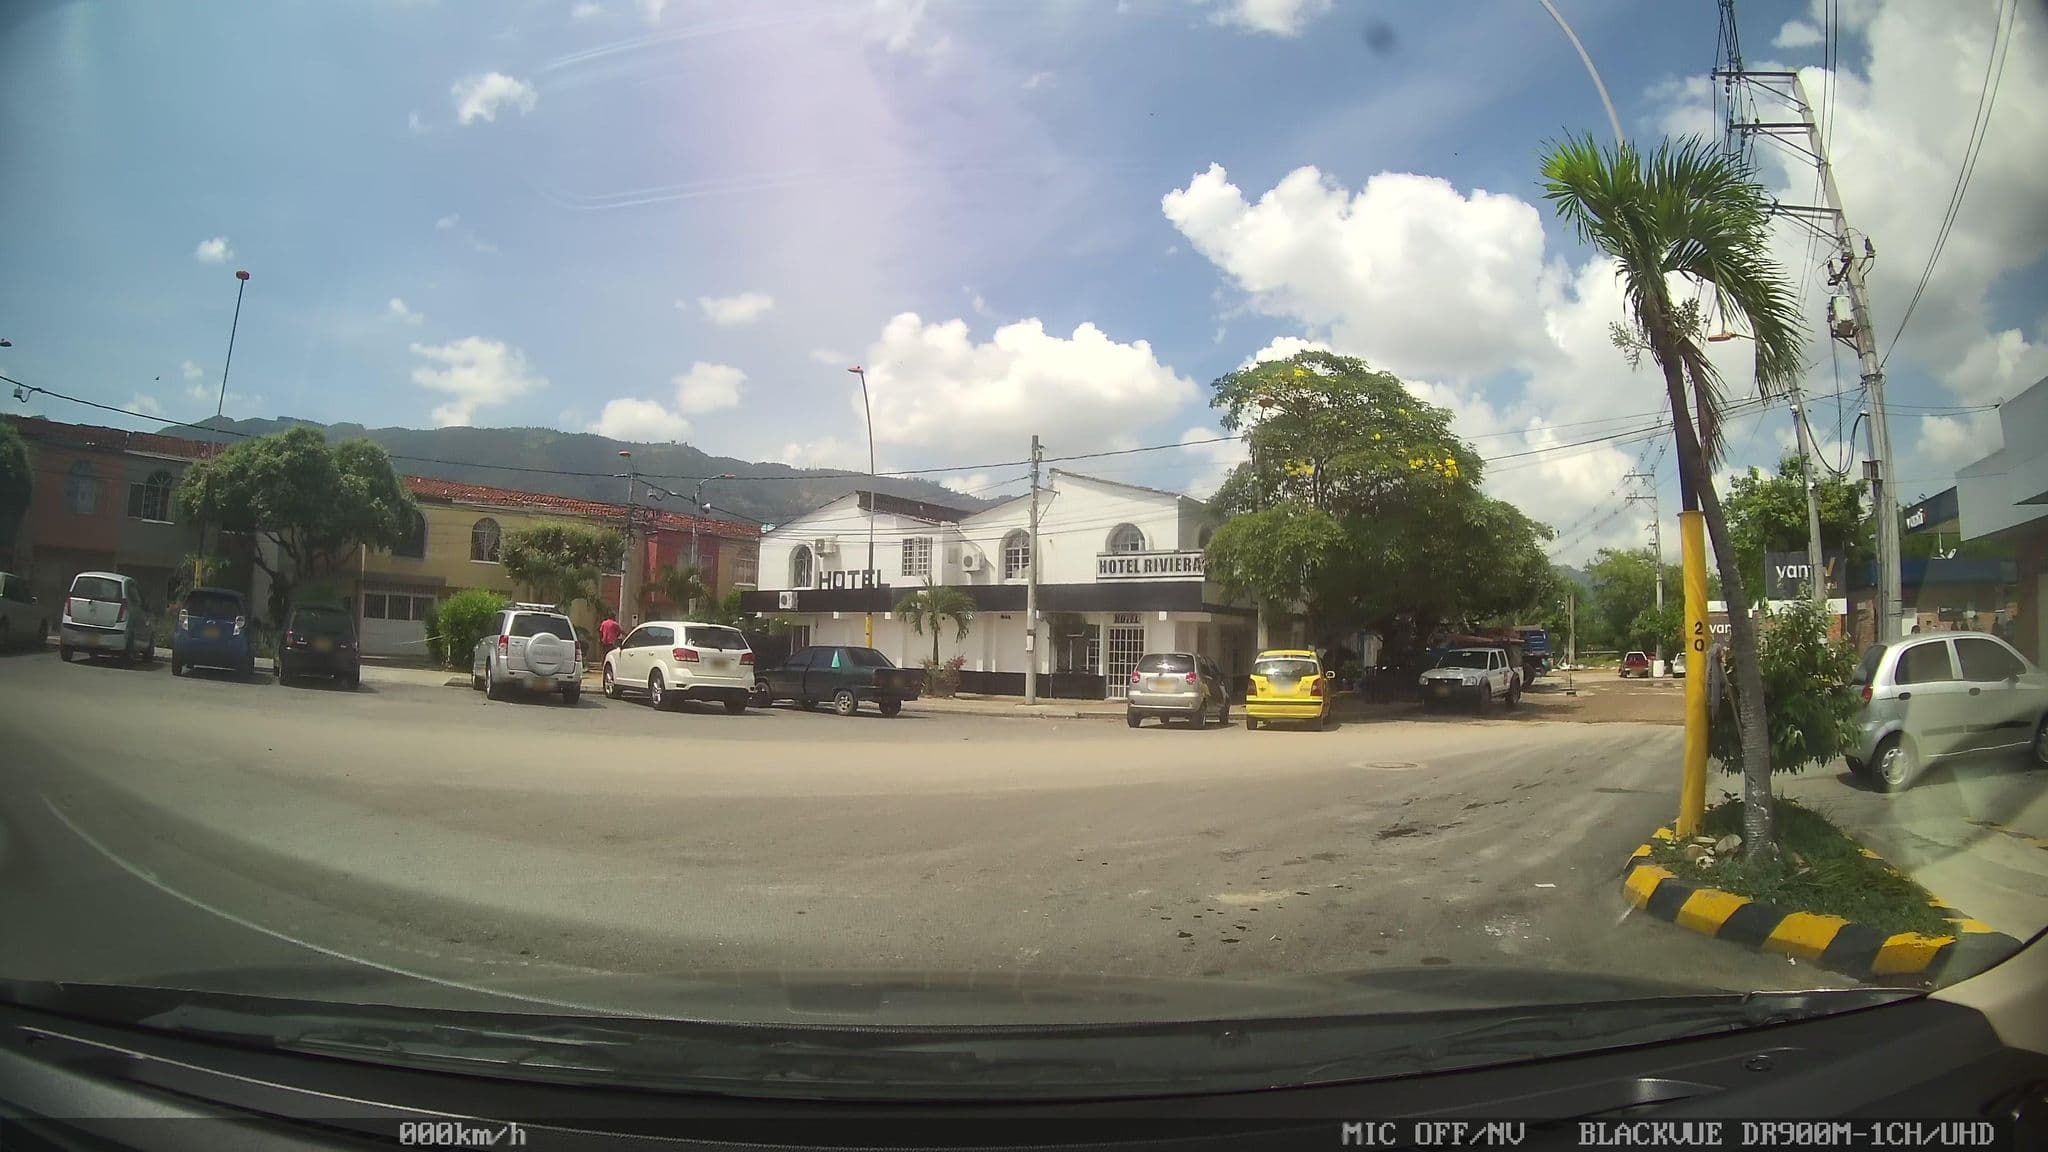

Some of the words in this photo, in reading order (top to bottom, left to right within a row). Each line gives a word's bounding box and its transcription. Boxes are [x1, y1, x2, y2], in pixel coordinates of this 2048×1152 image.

[1099, 559, 1140, 574] HOTEL
[1144, 557, 1203, 573] RIVIERA
[1776, 564, 1812, 579] van
[819, 569, 890, 590] HOTEL
[1114, 613, 1141, 624] HOTEL
